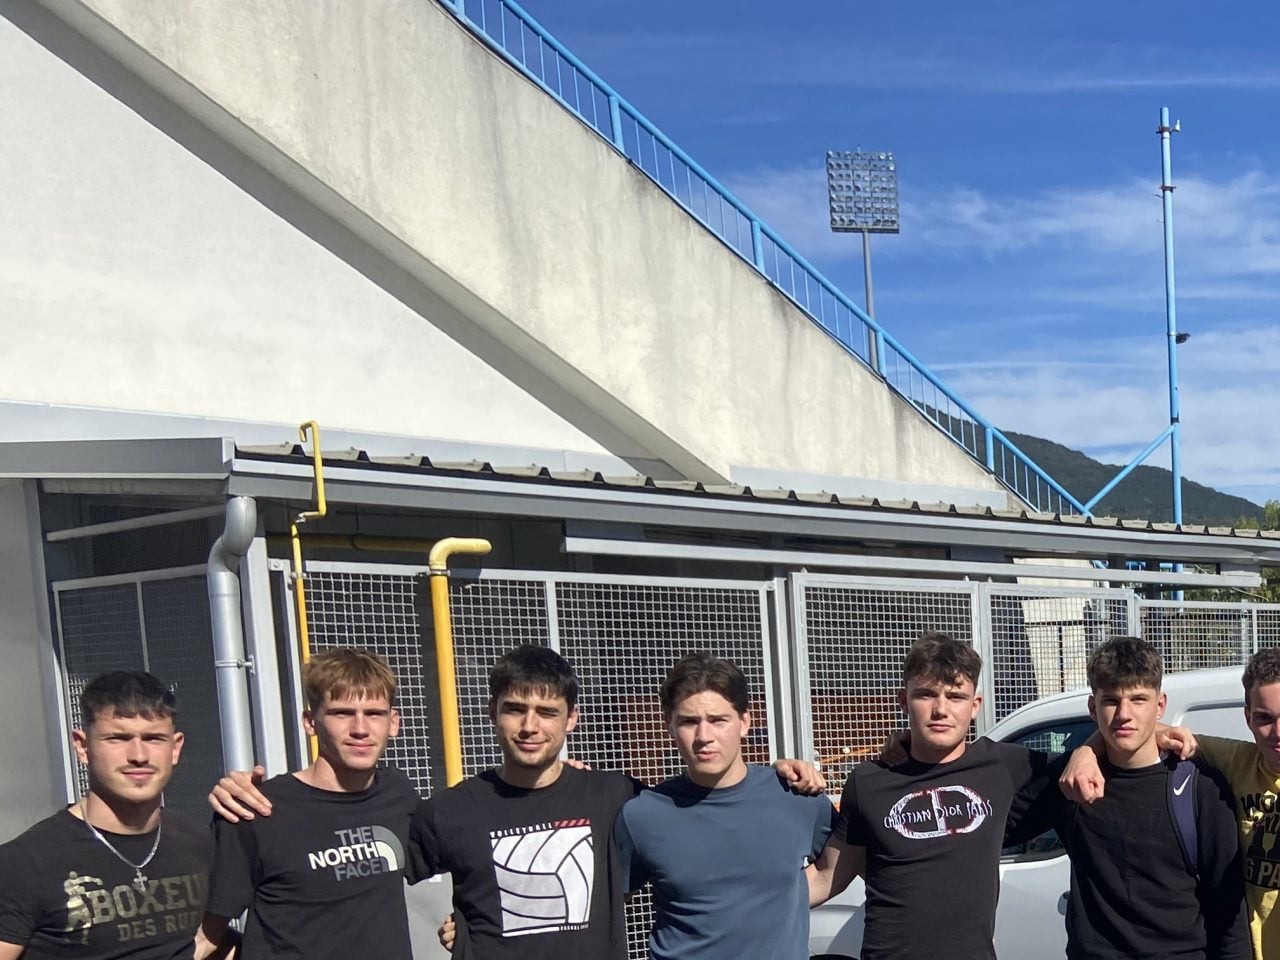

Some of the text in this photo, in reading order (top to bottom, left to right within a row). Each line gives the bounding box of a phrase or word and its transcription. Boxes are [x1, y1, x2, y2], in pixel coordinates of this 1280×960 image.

[884, 809, 931, 828] CHRISTIAN
[936, 804, 963, 820] DIOR
[334, 826, 373, 846] THE
[489, 822, 552, 838] VOLLEYBALL
[308, 841, 379, 870] NORTH
[334, 858, 381, 881] FACE
[118, 918, 157, 941] DES
